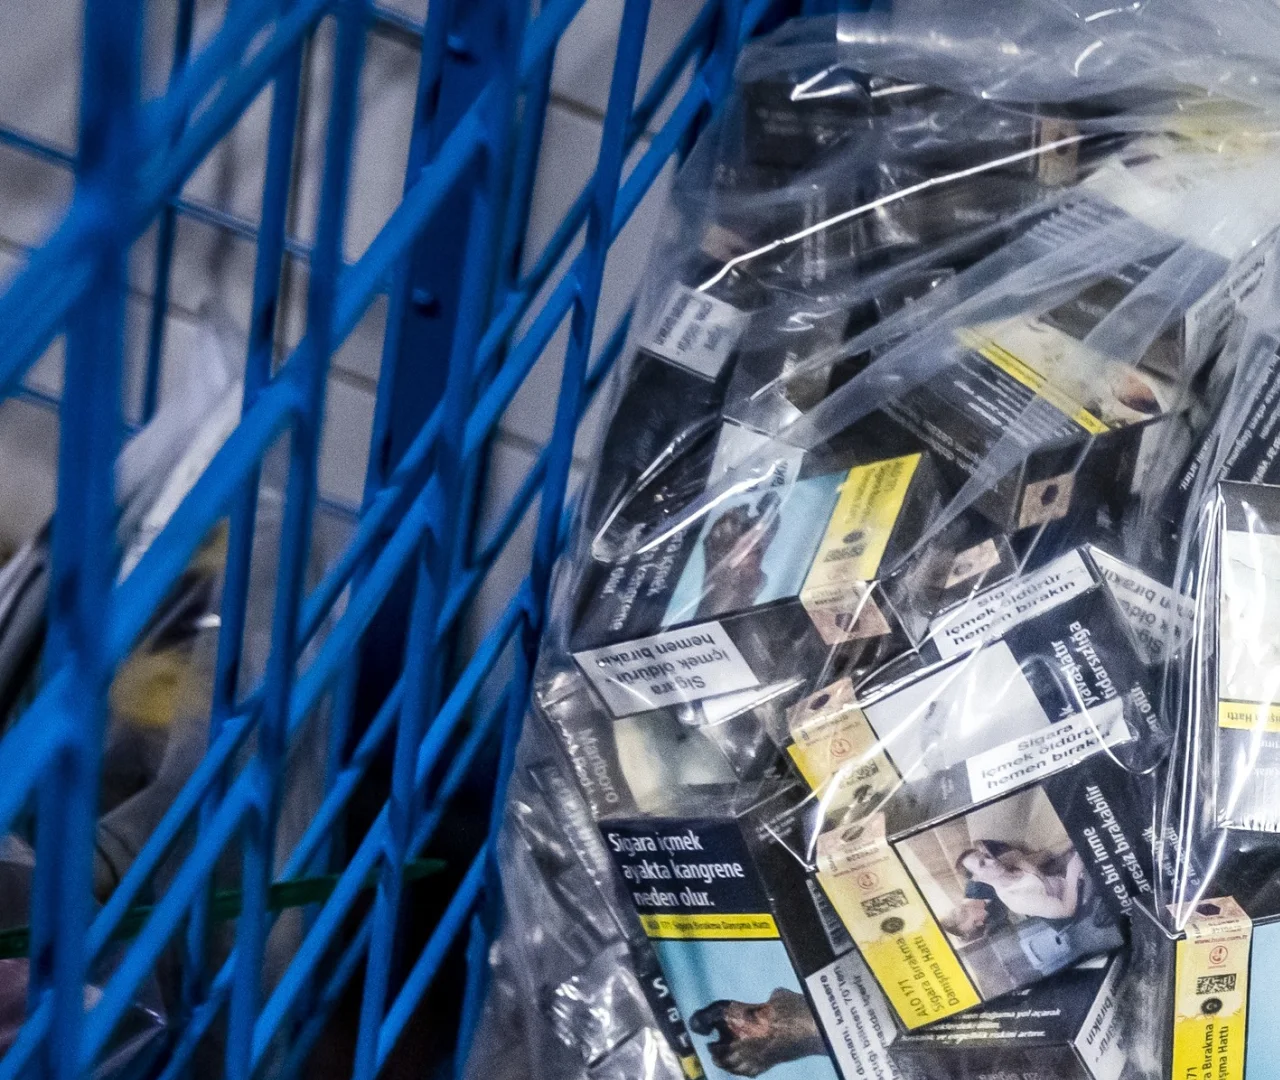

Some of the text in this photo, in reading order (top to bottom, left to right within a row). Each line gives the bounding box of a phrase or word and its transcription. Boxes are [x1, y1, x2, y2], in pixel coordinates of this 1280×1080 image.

[943, 604, 997, 638] içmek
[614, 642, 731, 687] içmek öldürür
[655, 629, 715, 659] hemen
[1065, 617, 1118, 702] tidarsızlığa
[649, 670, 706, 701] Sigara
[1048, 632, 1100, 709] yavaşlatır
[1016, 718, 1075, 755] Sigara
[1225, 710, 1252, 724] Hattı
[979, 748, 1035, 783] içmek
[985, 755, 1049, 792] hemen
[608, 829, 703, 856] Sigara içmek
[1081, 779, 1152, 898] aresiz bırakabilir
[621, 859, 745, 883] ayakta kangrene
[1079, 823, 1137, 920] dece bir inme
[632, 886, 715, 906] neden olur.
[892, 934, 945, 1013] Sigara Bırakma
[911, 932, 962, 1007] Danışma Hattı
[816, 972, 846, 1026] kansere
[896, 975, 929, 1020] ALO 171
[864, 1006, 889, 1050] madde
[1079, 996, 1117, 1046] bırakın
[1217, 1023, 1231, 1054] Hattı
[837, 1024, 868, 1077] dumanı,
[1199, 1021, 1217, 1069] Bırakma
